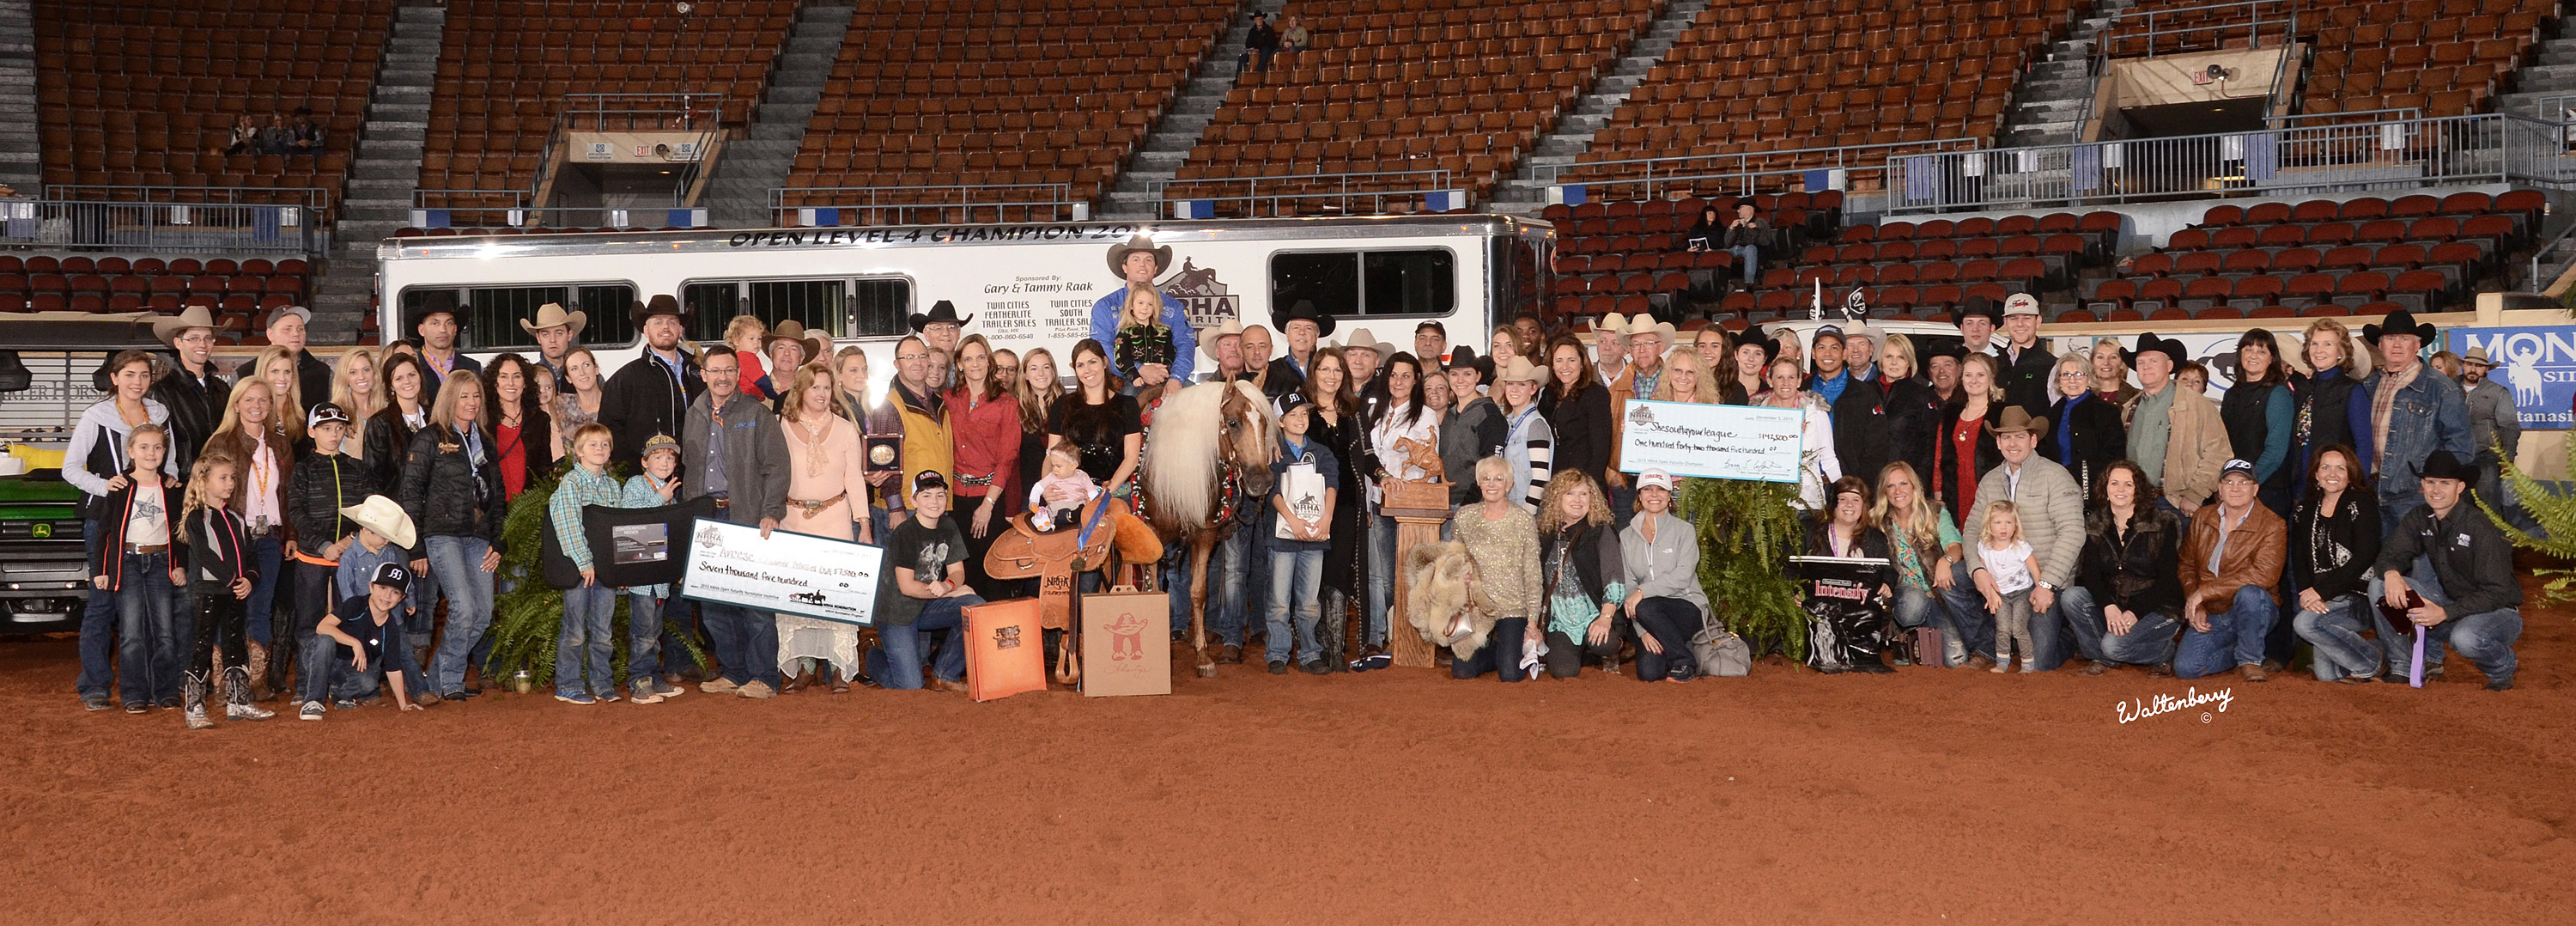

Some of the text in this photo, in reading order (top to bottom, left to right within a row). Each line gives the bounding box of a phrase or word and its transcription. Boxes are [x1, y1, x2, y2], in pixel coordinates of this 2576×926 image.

[636, 145, 650, 155] EXIT
[729, 231, 806, 247] OPEN
[812, 228, 896, 245] LEVEL
[904, 228, 921, 243] 4
[931, 225, 1085, 242] CHAMPION
[984, 282, 1093, 295] Gary & Tammy Raak
[987, 301, 1030, 310] TWIN CITIES
[1050, 299, 1093, 308] TWIN CITIES
[985, 309, 1032, 319] FEATHERLITE
[1060, 308, 1083, 317] SOUTH
[981, 319, 1036, 328] TRAILER SALES
[1045, 318, 1090, 326] TRAILER SAL
[1649, 439, 1674, 449] hundred
[1705, 444, 1728, 453] thousand
[1742, 445, 1765, 454] hundred
[1293, 503, 1320, 512] NRHA
[697, 533, 722, 542] NRHA
[699, 560, 724, 575] Seven
[725, 564, 758, 581] thousand
[762, 571, 775, 582] five
[777, 576, 809, 588] hundred
[1044, 575, 1071, 590] NRHA
[1815, 580, 1869, 606] Intensify
